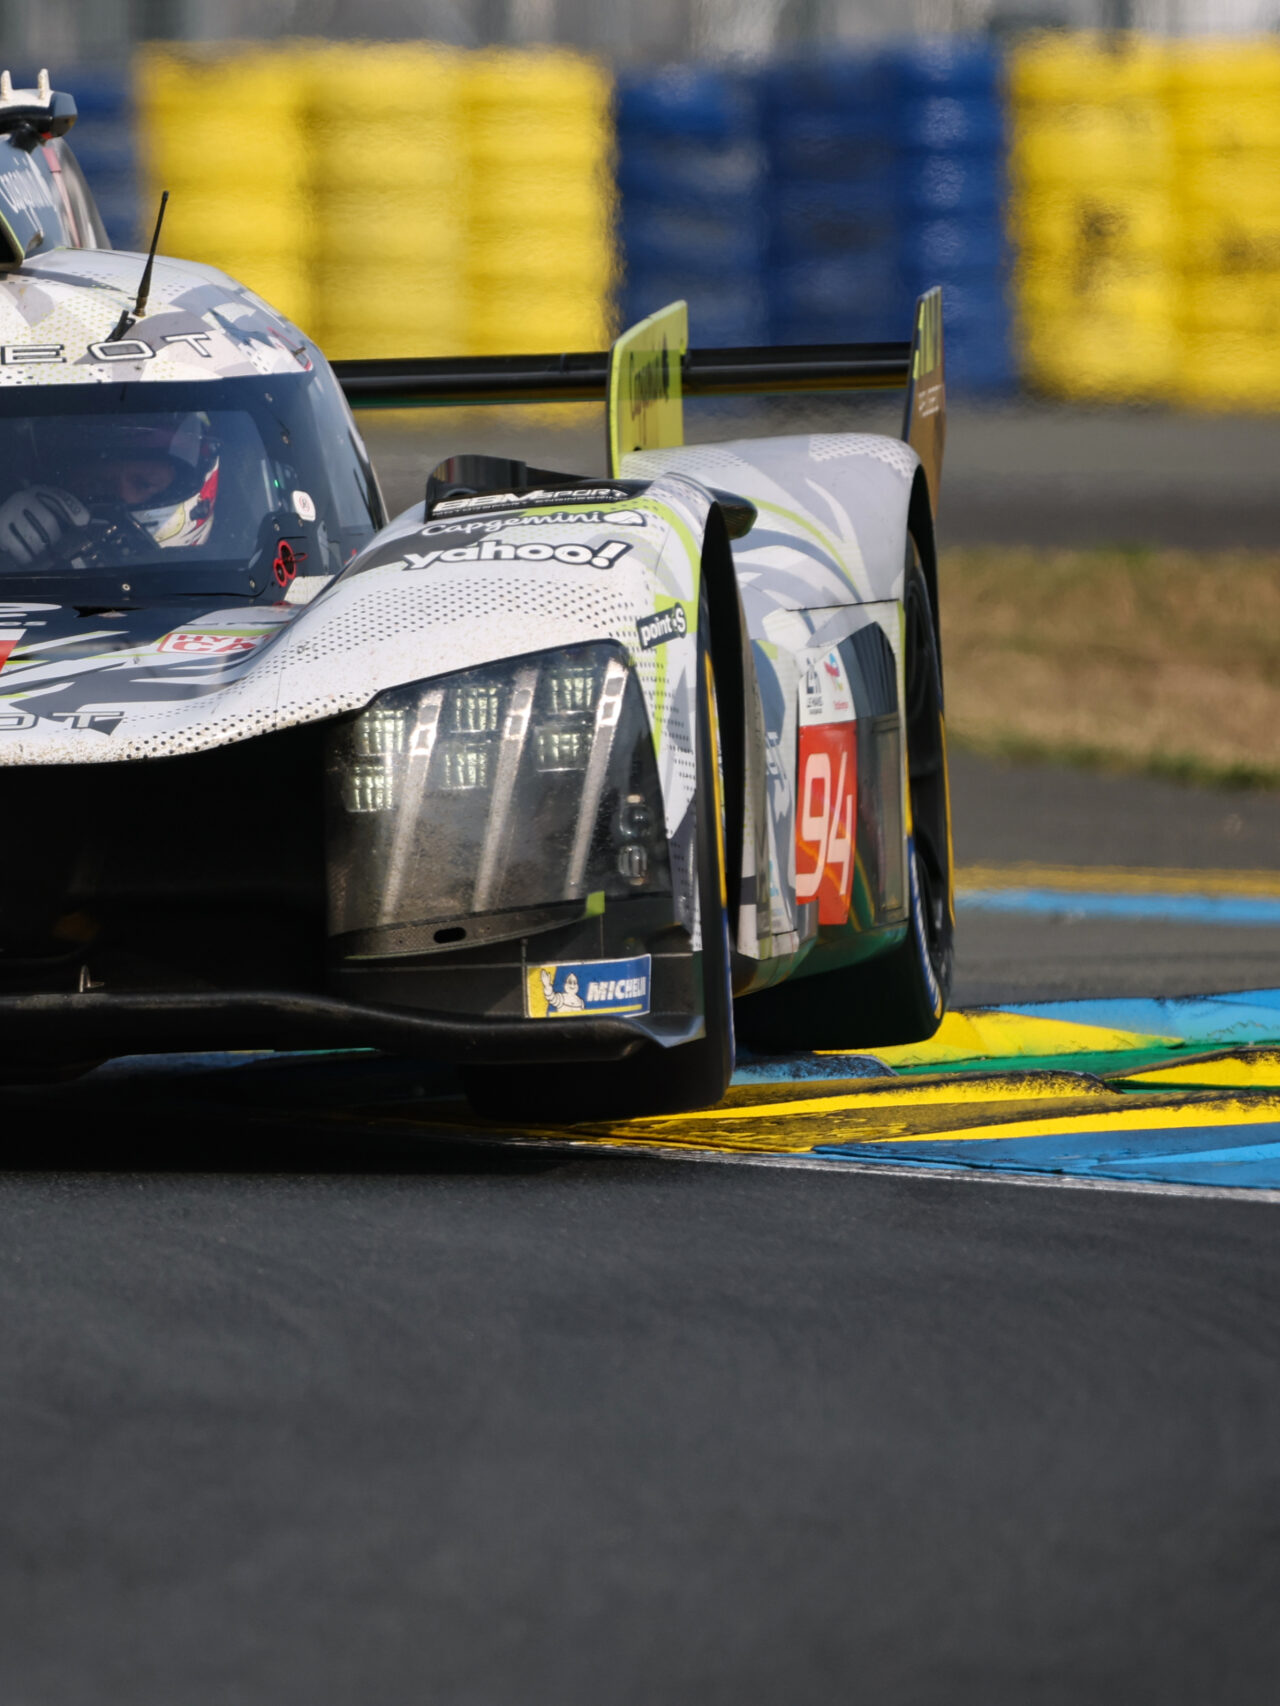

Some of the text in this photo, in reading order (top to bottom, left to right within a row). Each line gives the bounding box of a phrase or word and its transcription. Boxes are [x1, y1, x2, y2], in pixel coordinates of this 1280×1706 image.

[421, 510, 601, 537] Capgemini
[404, 540, 629, 569] yahoo!
[640, 613, 673, 647] point
[172, 641, 258, 653] CA
[796, 751, 853, 898] 94
